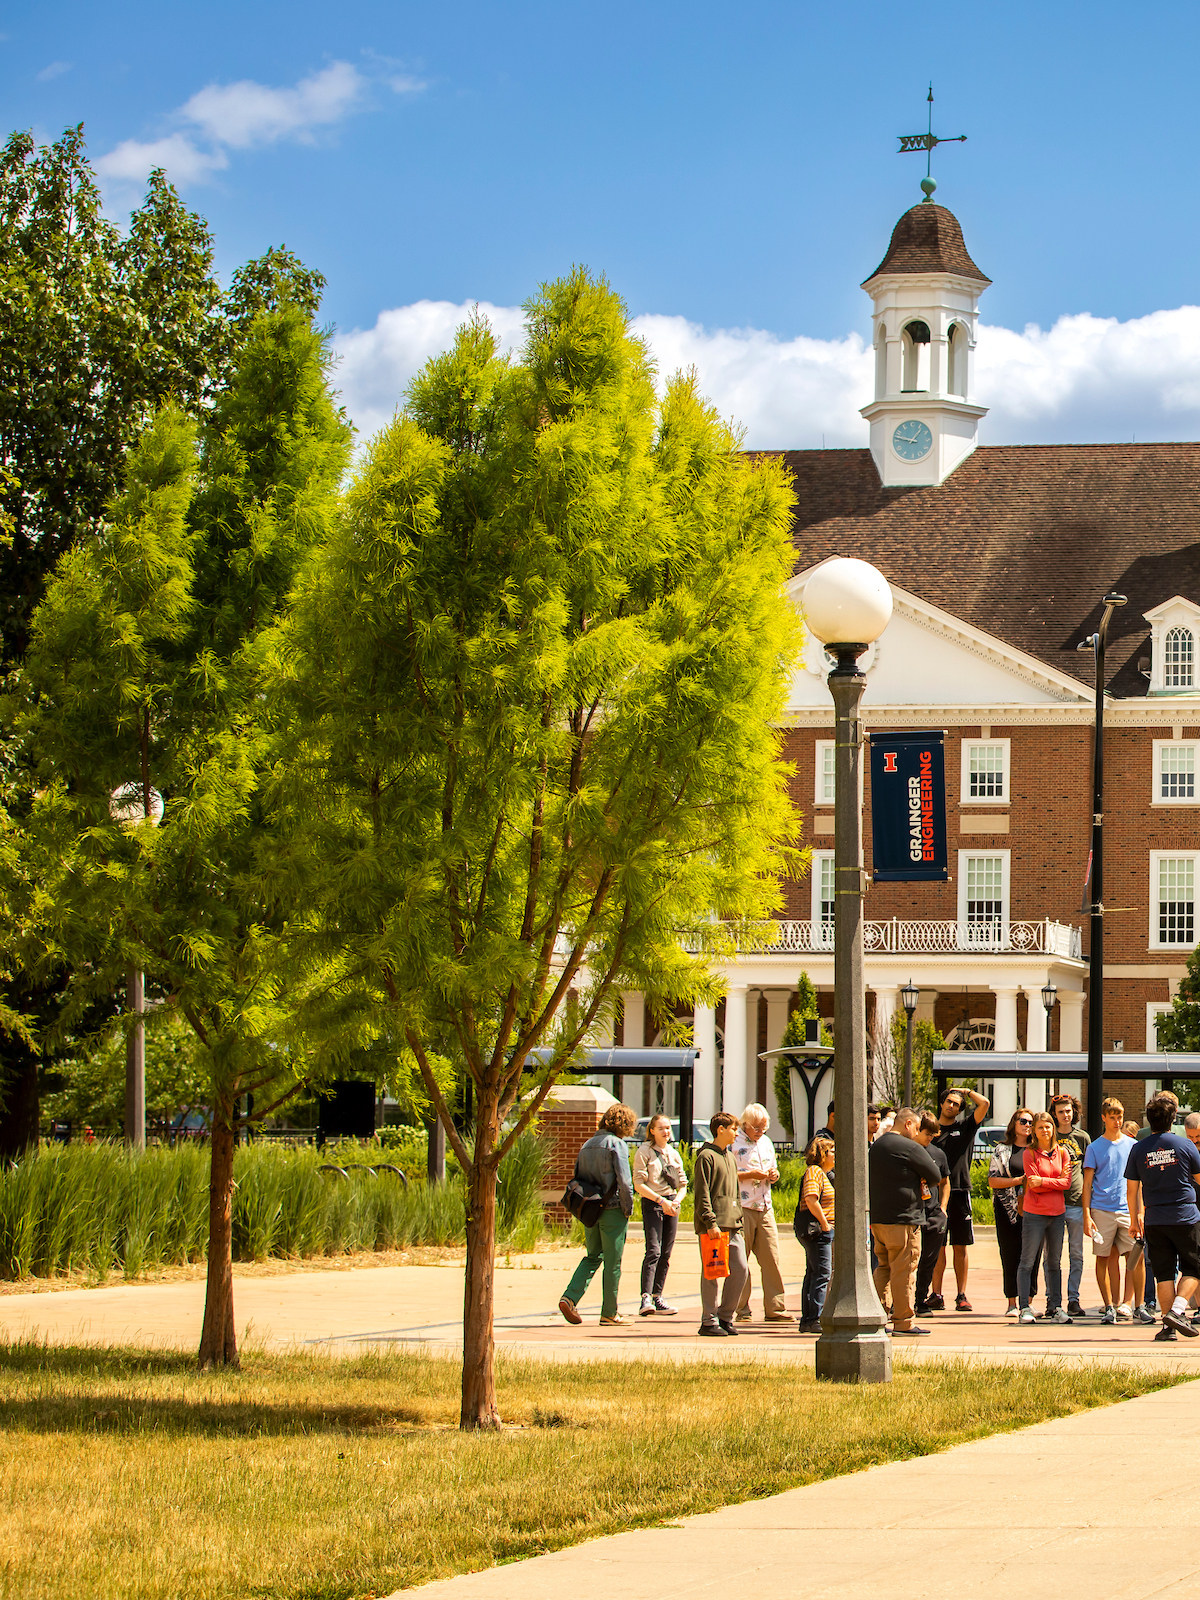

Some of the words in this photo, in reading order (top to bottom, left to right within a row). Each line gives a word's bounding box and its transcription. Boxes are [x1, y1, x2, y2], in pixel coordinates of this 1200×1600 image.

[908, 776, 923, 862] GRAINGER
[920, 751, 935, 861] ENGINEERING
[1146, 1149, 1175, 1158] WELCOMING
[1149, 1157, 1176, 1166] ENGINEERS
